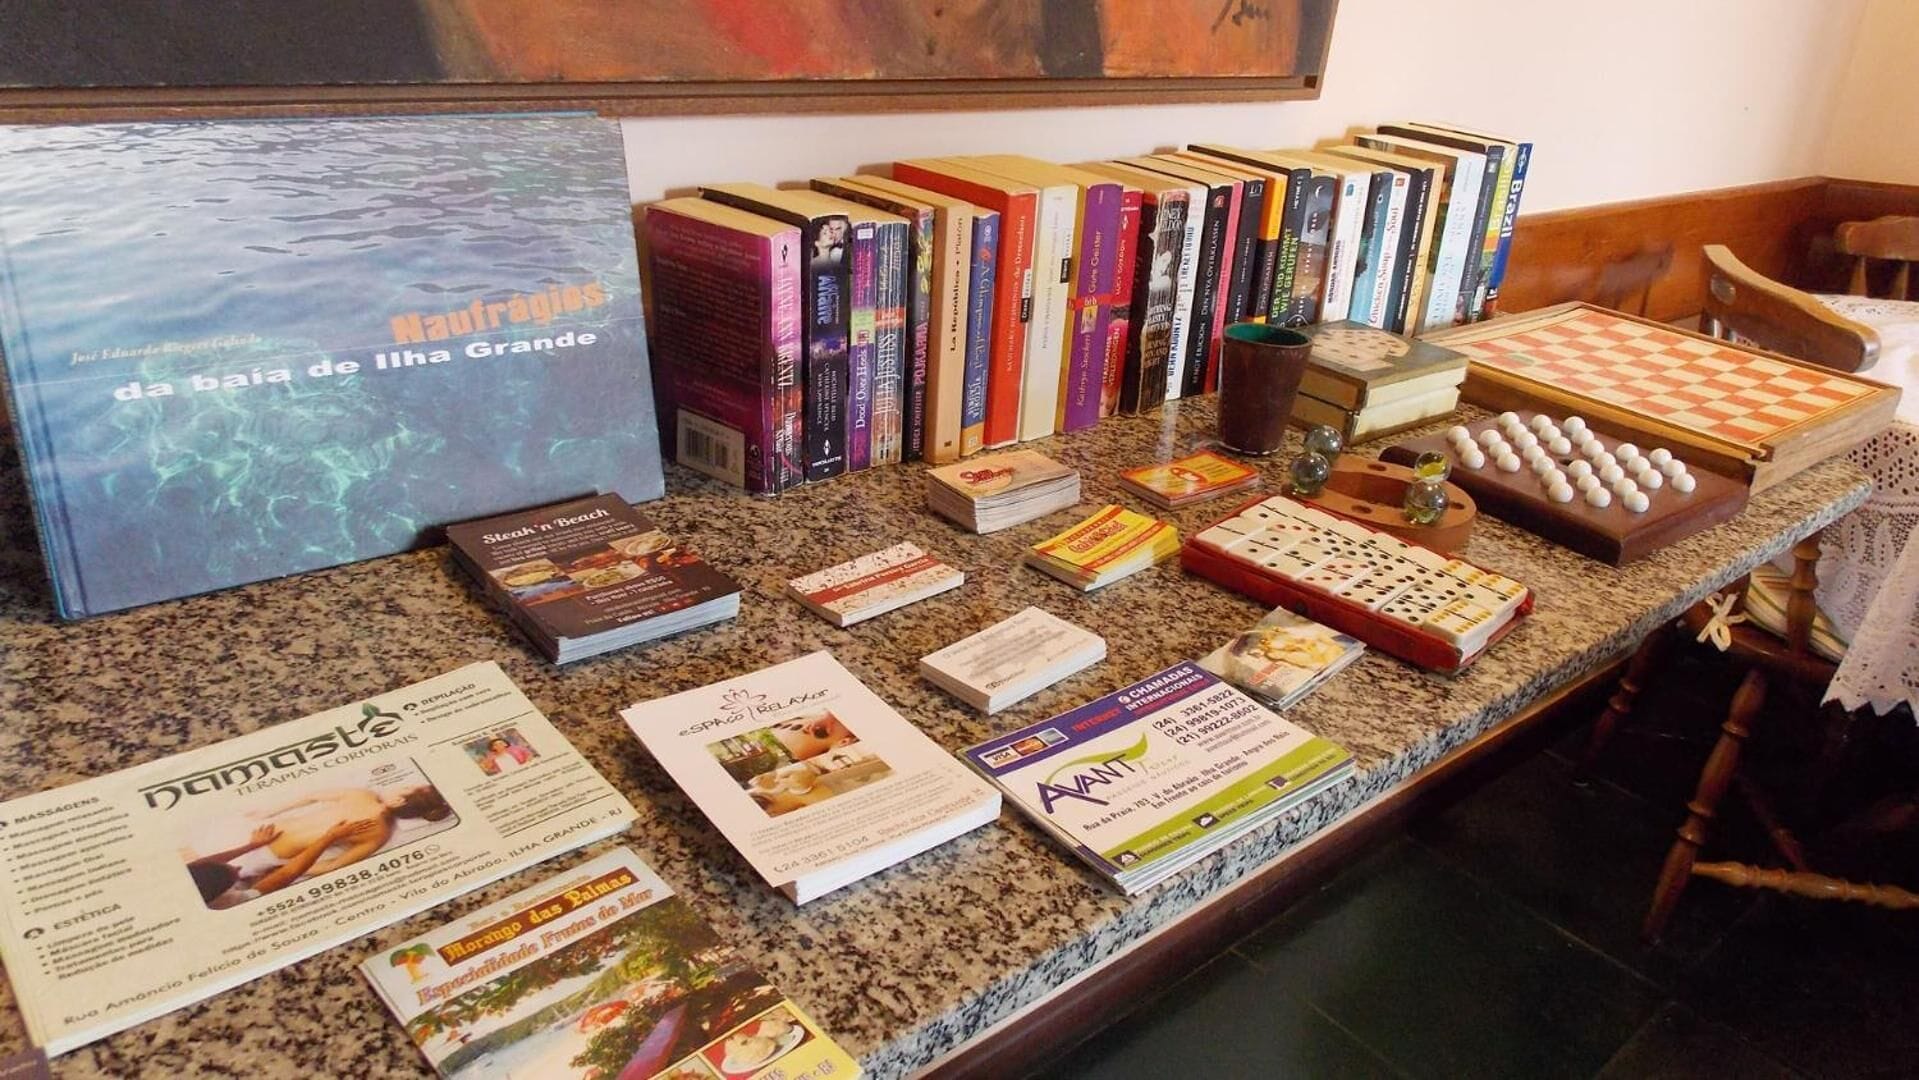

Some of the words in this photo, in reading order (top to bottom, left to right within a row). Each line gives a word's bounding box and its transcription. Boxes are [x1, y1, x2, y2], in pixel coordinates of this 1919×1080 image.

[1502, 180, 1523, 237] Brazil
[1090, 230, 1101, 265] Geister
[1279, 227, 1292, 270] KOMMT
[1284, 237, 1299, 288] GERUFEN
[1087, 268, 1098, 293] Gute
[1274, 274, 1284, 292] TOD
[1368, 281, 1383, 323] Chicken
[1377, 253, 1391, 280] Soup
[391, 280, 607, 346] Naufrágios
[950, 270, 960, 333] República
[1272, 296, 1280, 318] DER
[1281, 291, 1290, 312] WIE
[950, 337, 957, 351] La
[1079, 334, 1091, 368] Stockett
[113, 380, 175, 402] da
[193, 366, 293, 393] baía
[307, 356, 360, 379] de
[376, 346, 452, 370] Ilha
[465, 331, 598, 359] Grande
[875, 379, 900, 414] JULIA
[1077, 371, 1088, 407] Kathryn
[554, 509, 608, 526] Beach
[1126, 674, 1202, 711] INTERNACIONAIS
[1130, 667, 1193, 699] CHAMADAS
[1151, 716, 1177, 730] (24)
[1181, 689, 1233, 716] 3361-5822
[1163, 724, 1188, 738] (24)
[1186, 697, 1245, 726] 99819-1073
[1175, 731, 1200, 746] (21)
[1198, 704, 1257, 734] 99222-8602
[237, 767, 318, 795] TERAPIAS
[324, 736, 417, 767] CORPORAIS
[1036, 754, 1136, 814] AVANT
[1083, 821, 1100, 831] Rua
[1172, 776, 1198, 790] Abraão
[1214, 754, 1240, 771] Grande
[1242, 744, 1264, 756] Angra
[1273, 731, 1290, 740] Reis
[15, 798, 98, 823] MASSAGENS
[1164, 790, 1188, 804] frente
[258, 896, 304, 915] +5524
[309, 851, 423, 897] 99838.4076
[54, 904, 120, 929] ESTÉTICA
[64, 1007, 100, 1025] Rua
[106, 981, 182, 1010] Amâncio
[188, 959, 240, 981] Felício
[246, 948, 267, 960] de
[271, 930, 318, 950] Souza
[335, 904, 385, 925] Centro
[400, 886, 427, 899] Vila
[509, 843, 540, 857] ILHA
[543, 818, 595, 842] GRANDE
[609, 808, 623, 817] RJ
[442, 916, 525, 964] Morango
[530, 898, 564, 926] das
[566, 866, 634, 909] Palmas
[419, 940, 542, 1003] Especialidade
[541, 917, 596, 948] Frutos
[596, 901, 620, 922] de
[618, 884, 655, 911] Mar
